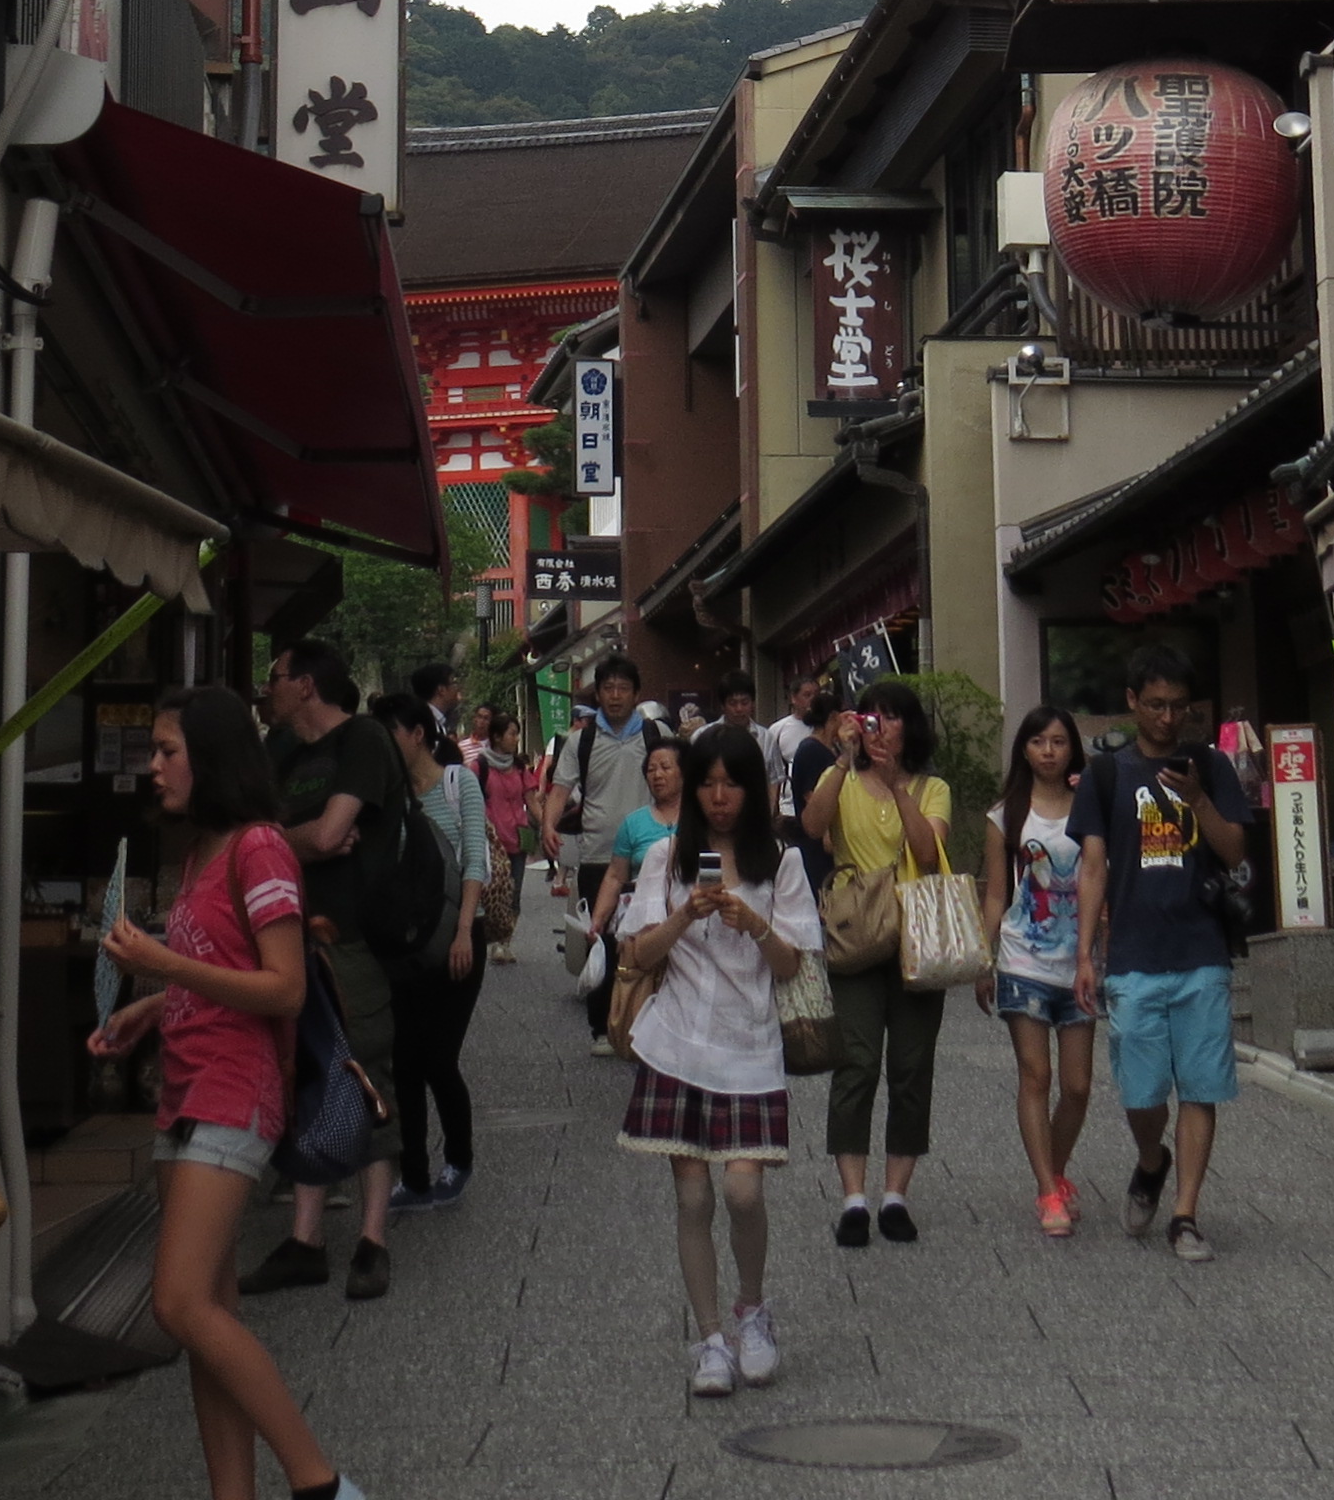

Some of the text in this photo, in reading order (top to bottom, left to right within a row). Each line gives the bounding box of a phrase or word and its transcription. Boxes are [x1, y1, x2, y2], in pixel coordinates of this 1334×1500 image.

[1152, 73, 1213, 218] 聖護院
[823, 228, 880, 386] 桜士堂
[579, 401, 601, 483] 朝日堂
